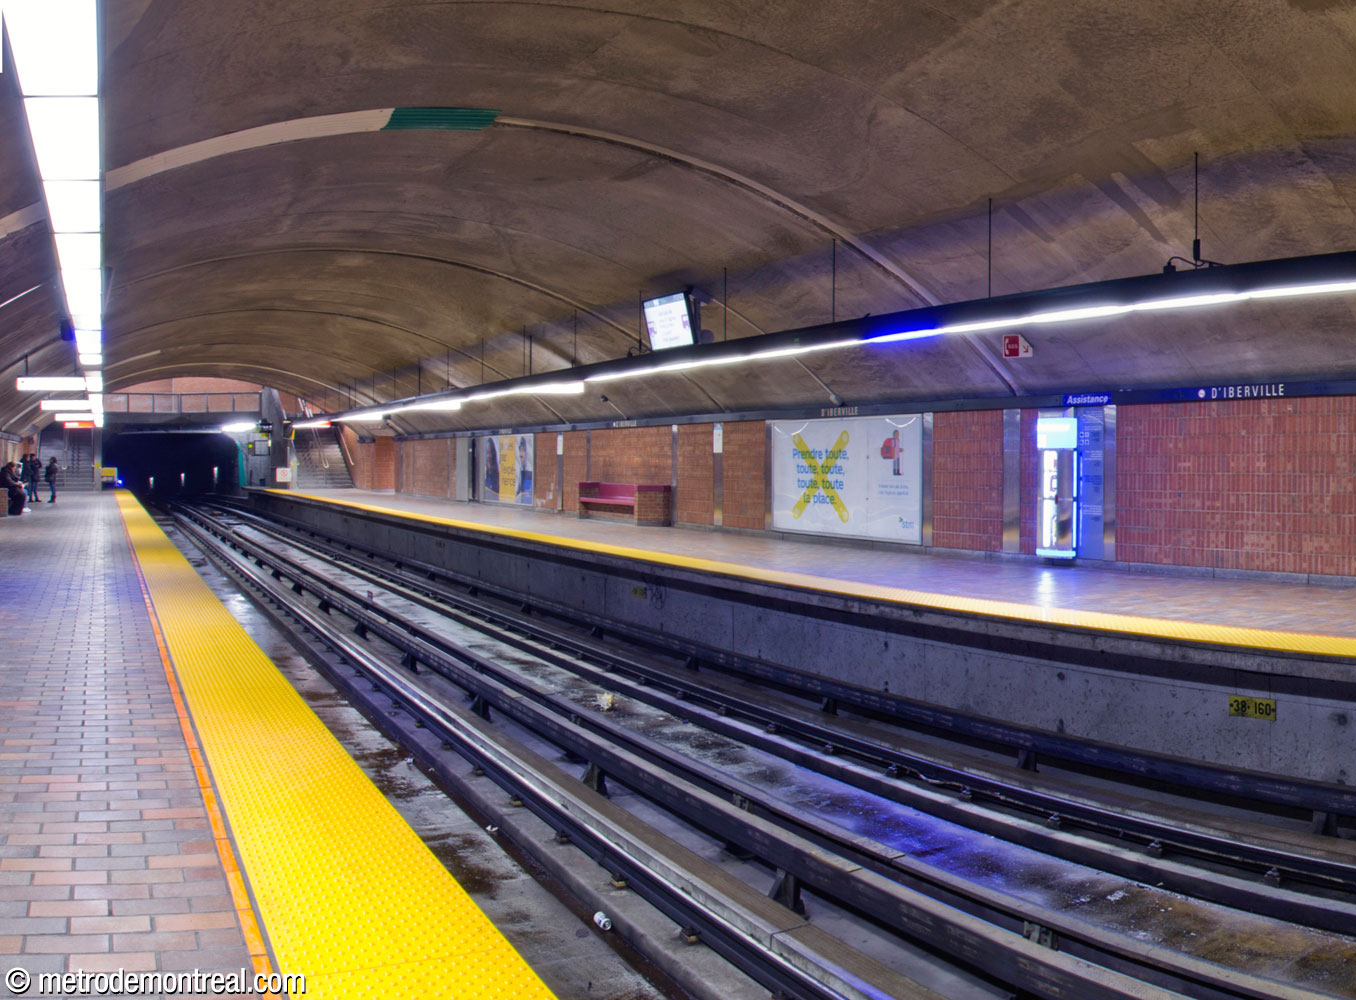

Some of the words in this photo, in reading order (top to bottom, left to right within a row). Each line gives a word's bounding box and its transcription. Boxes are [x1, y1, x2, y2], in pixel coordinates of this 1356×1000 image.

[1211, 384, 1285, 399] D'IBERVILLE
[1067, 395, 1109, 404] Assistance
[820, 406, 859, 416] D'IBERVILLE
[792, 448, 823, 460] Prendre
[825, 448, 850, 461] toute,
[796, 463, 819, 475] toute,
[821, 463, 845, 476] toute,
[822, 478, 844, 490] toute
[803, 492, 811, 503] la
[812, 493, 837, 505] place.
[1254, 701, 1271, 716] 160
